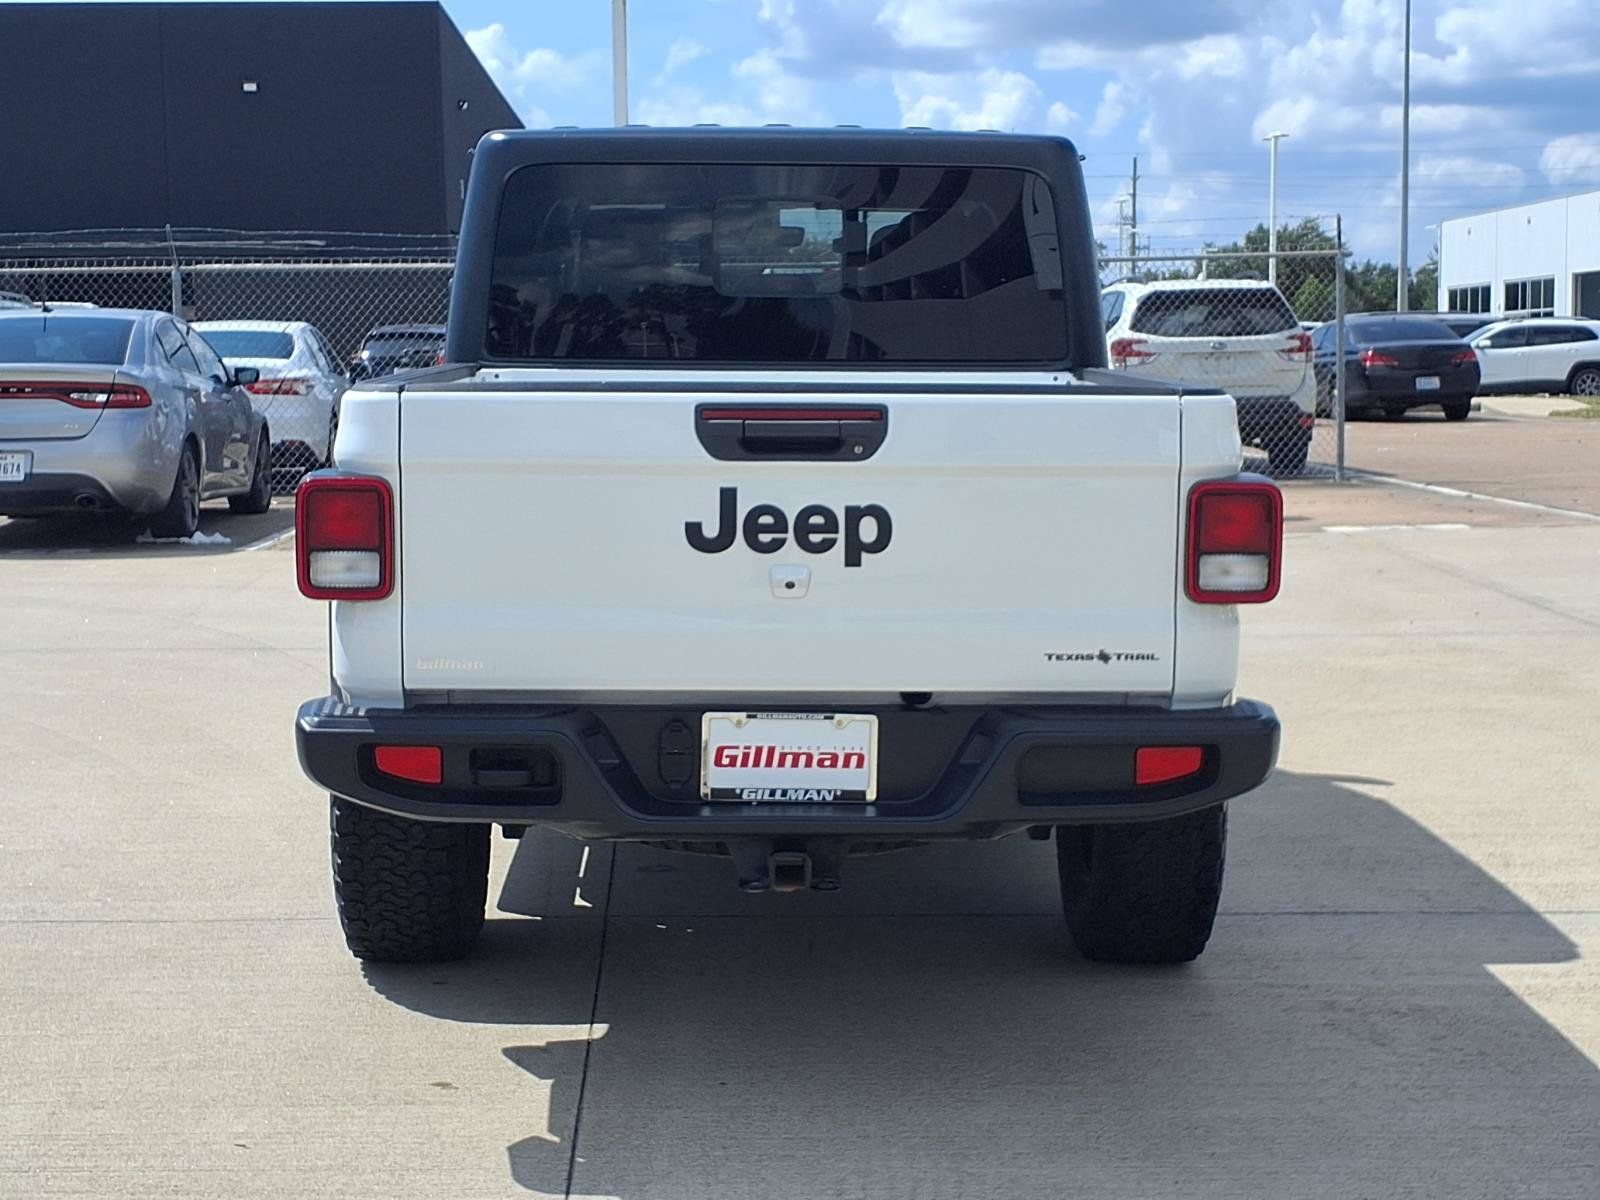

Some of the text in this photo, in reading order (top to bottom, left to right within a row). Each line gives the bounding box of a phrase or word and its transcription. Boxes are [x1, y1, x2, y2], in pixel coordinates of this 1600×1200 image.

[685, 487, 892, 567] Jeep
[1043, 652, 1160, 661] TEXAS TRAIL
[714, 745, 865, 769] Gillman
